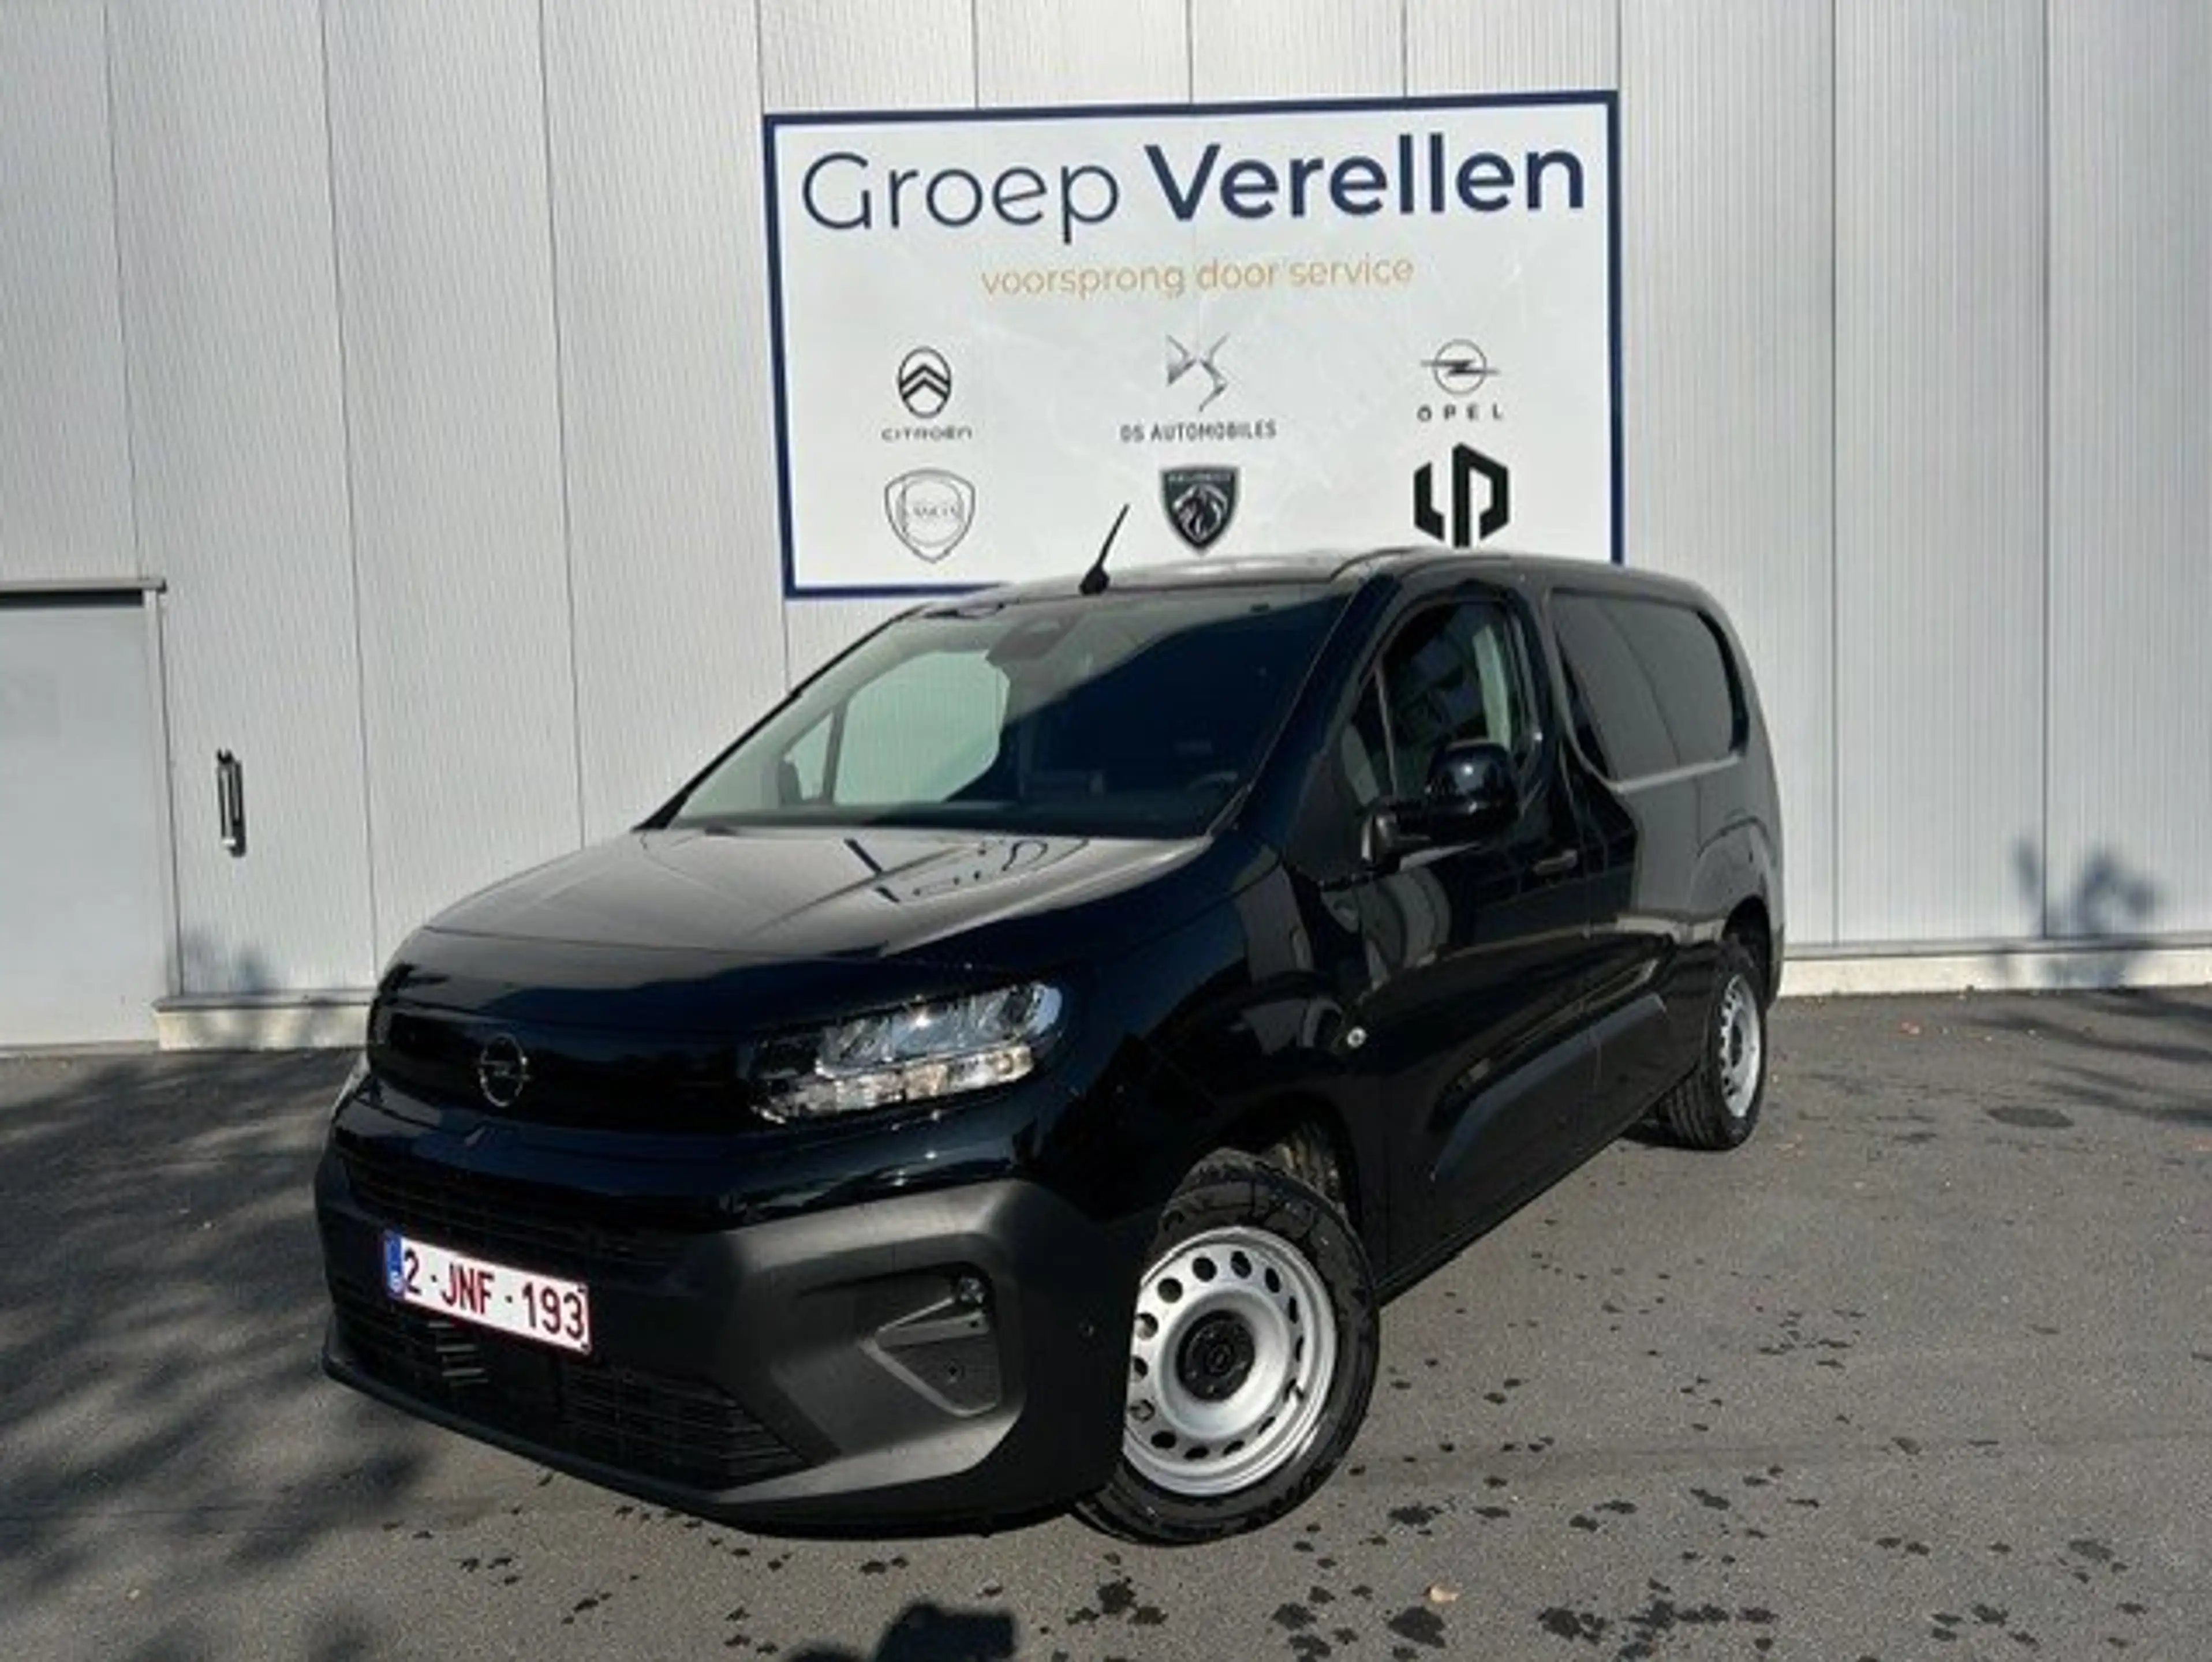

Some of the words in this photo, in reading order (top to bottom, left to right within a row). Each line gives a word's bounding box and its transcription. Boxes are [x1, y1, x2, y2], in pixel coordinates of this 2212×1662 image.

[802, 152, 1119, 245] Groep
[1144, 132, 1583, 220] Verellen
[981, 263, 1185, 300] voorsprong
[1196, 259, 1277, 290] door
[1289, 252, 1414, 287] service
[1151, 418, 1277, 442] AUTOMOBILES
[1417, 402, 1504, 422] OPEL
